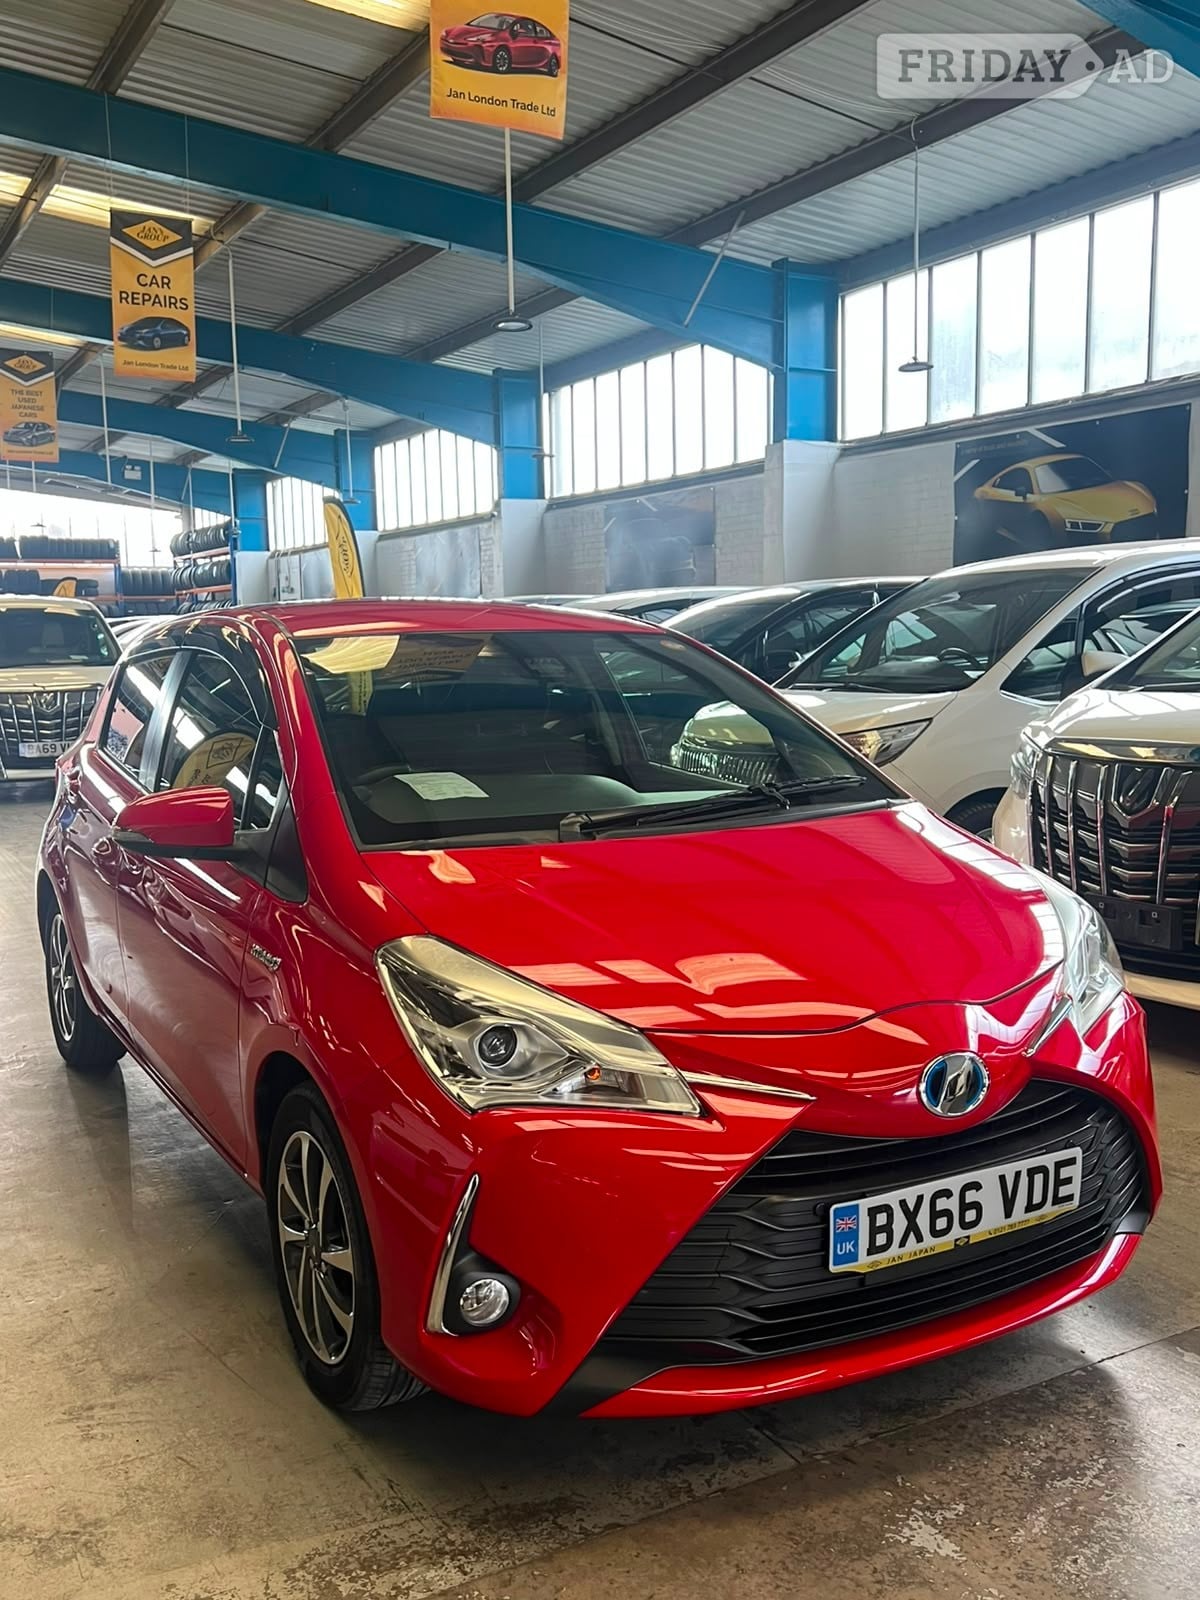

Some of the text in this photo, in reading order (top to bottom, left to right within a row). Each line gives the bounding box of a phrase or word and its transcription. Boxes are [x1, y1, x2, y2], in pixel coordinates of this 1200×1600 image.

[446, 87, 557, 117] Jan London Trade Ltd
[136, 232, 169, 243] GROUP
[136, 273, 171, 289] CAR
[119, 290, 189, 311] REPAIRS
[135, 360, 160, 369] London
[12, 404, 45, 412] JAPANESE
[866, 1156, 1077, 1256] BX66 VDE
[837, 1240, 855, 1255] UK
[887, 1255, 904, 1265] JAN
[908, 1245, 936, 1259] JAPAN
